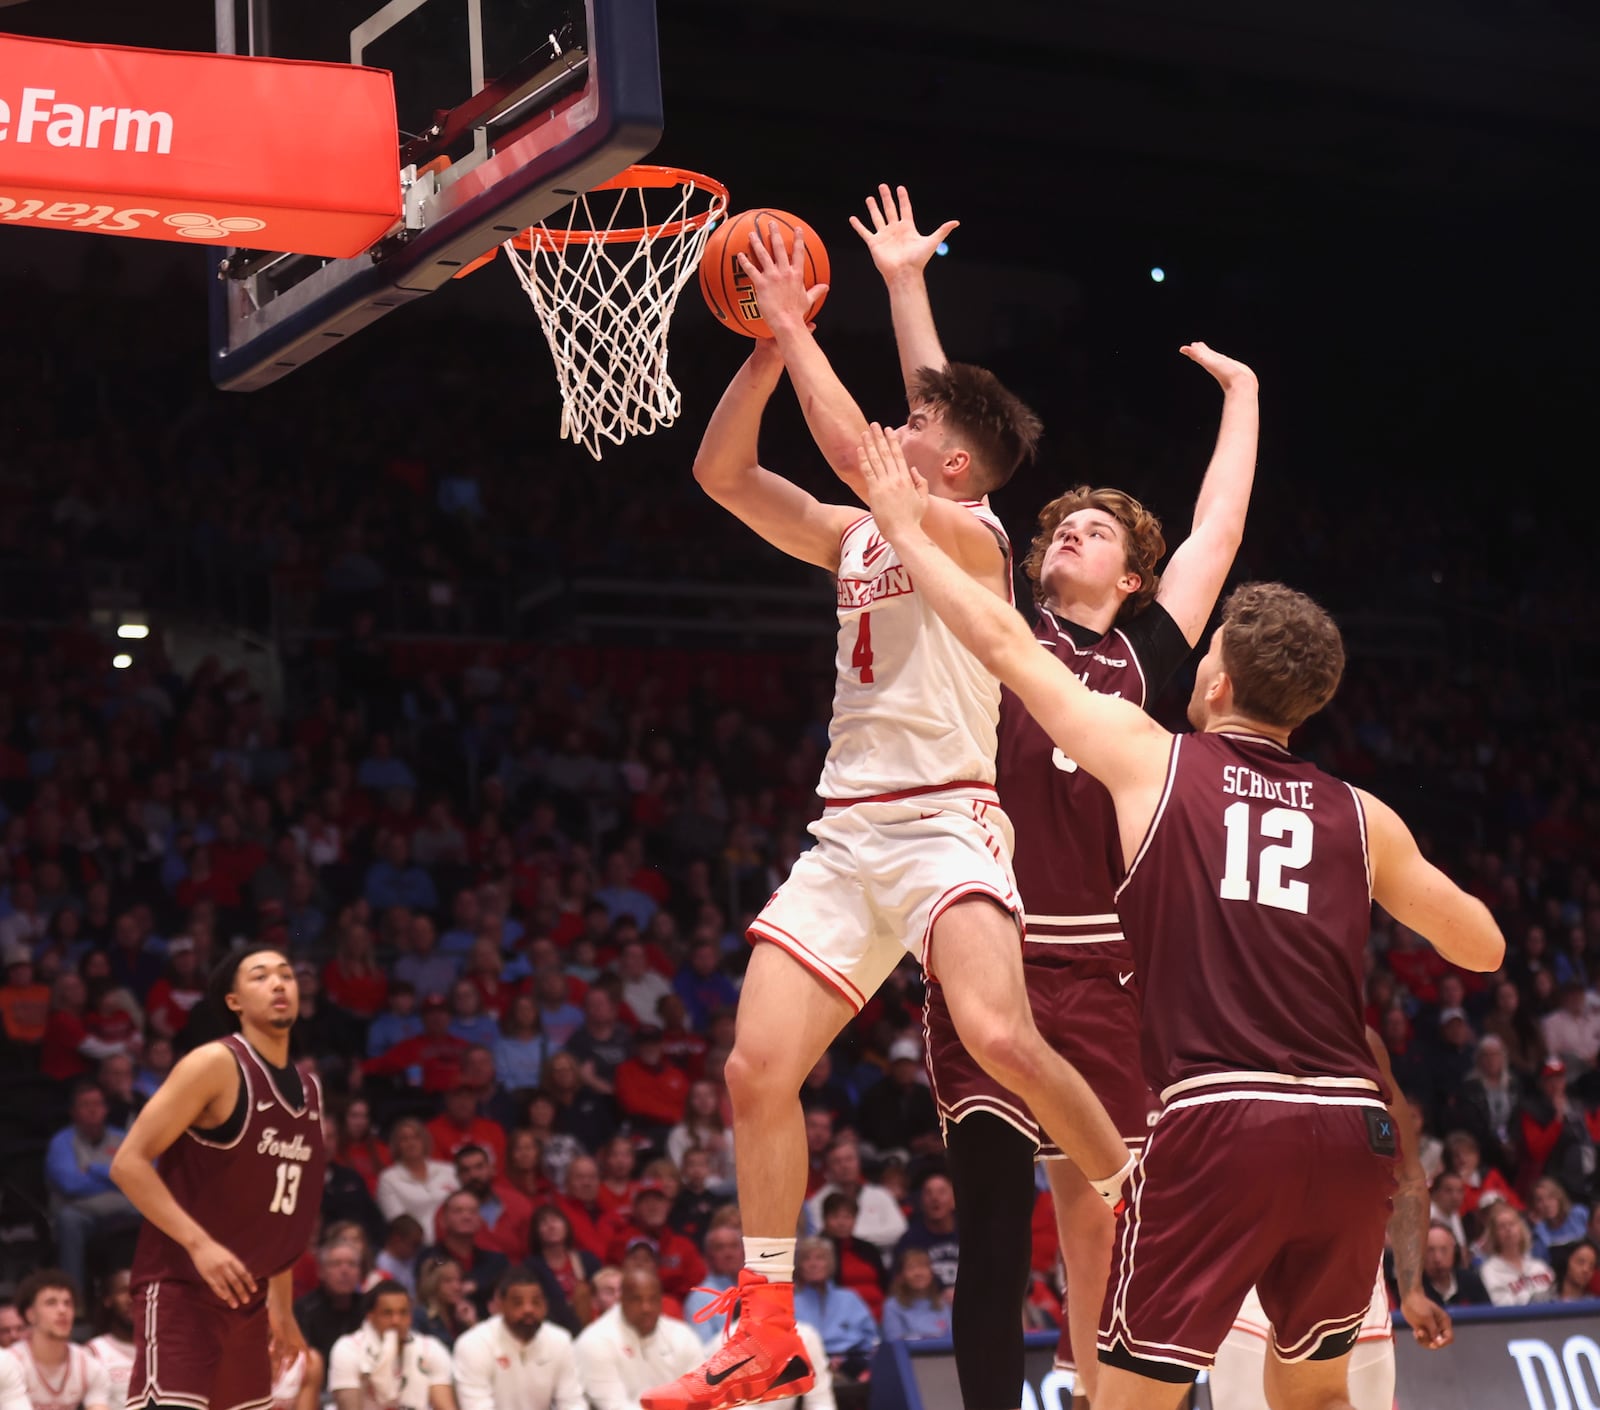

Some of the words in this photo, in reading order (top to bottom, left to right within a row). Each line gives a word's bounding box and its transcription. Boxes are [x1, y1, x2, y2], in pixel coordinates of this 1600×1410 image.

[17, 87, 174, 154] Farm
[852, 612, 874, 683] 4
[1223, 765, 1314, 810] SCHULTE
[1220, 801, 1314, 915] 12
[269, 1163, 302, 1215] 13
